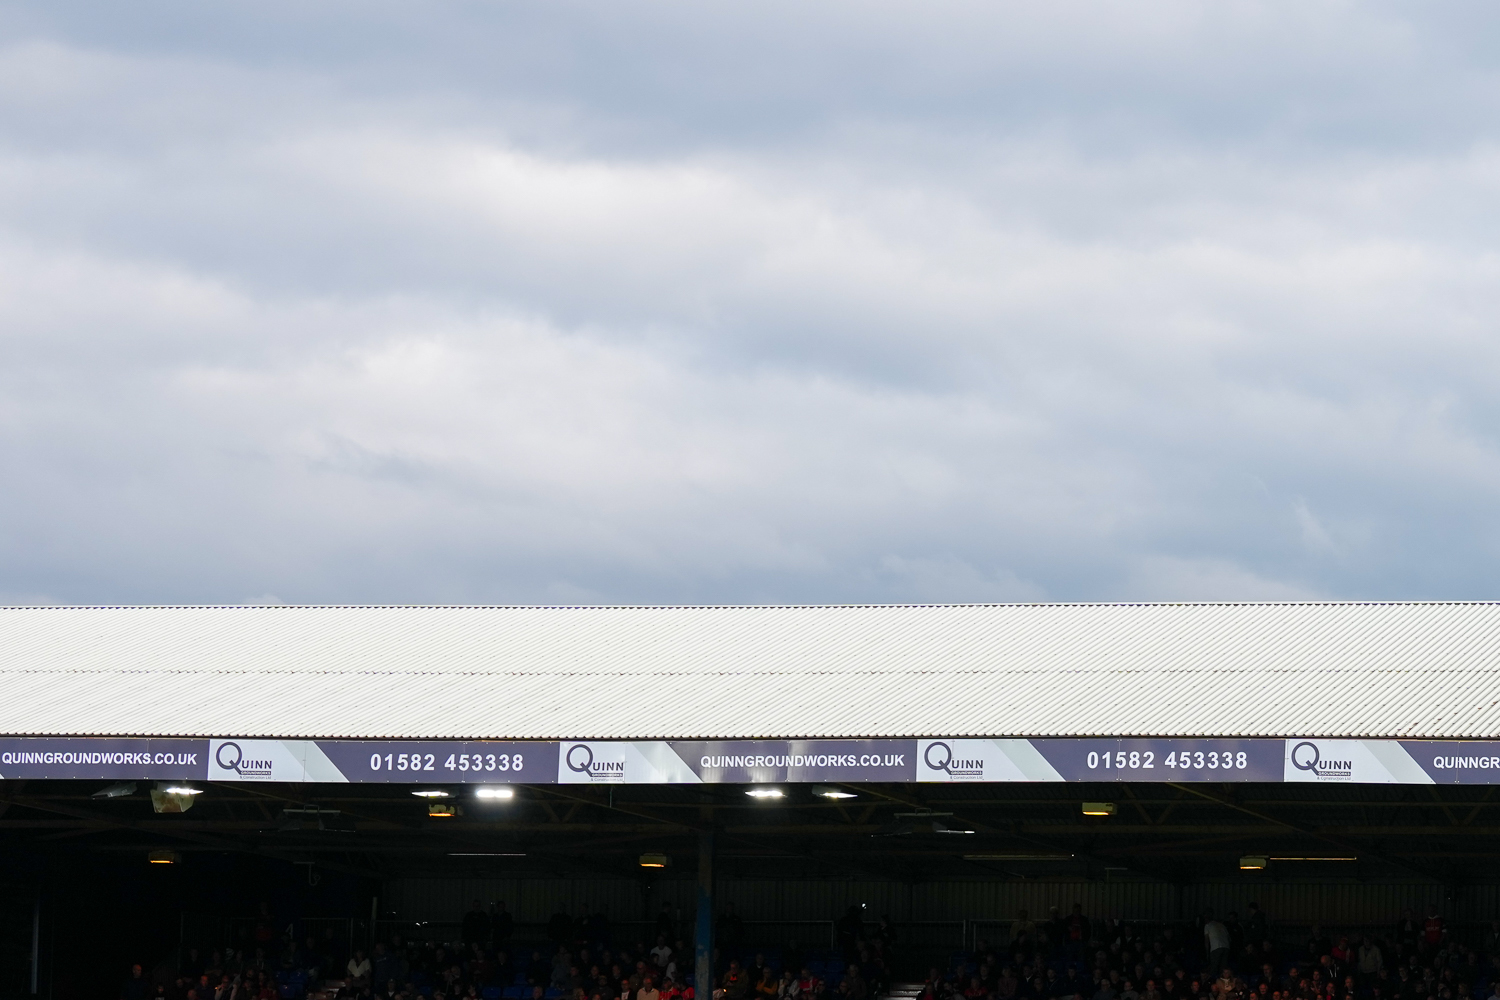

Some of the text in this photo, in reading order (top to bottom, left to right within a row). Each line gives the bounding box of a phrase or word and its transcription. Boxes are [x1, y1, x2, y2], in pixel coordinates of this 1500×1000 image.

[1, 752, 198, 765] QUINNGROUNDWORKS.CO.UK
[215, 741, 273, 774] QUINN
[369, 753, 524, 772] 01582 453338
[566, 743, 625, 777] QUINN
[700, 755, 905, 768] QUINNGROUNDWORKS.CO.UK
[924, 741, 984, 774] QUINN
[1086, 751, 1248, 769] 01582 453338
[1291, 741, 1352, 775] QUINN
